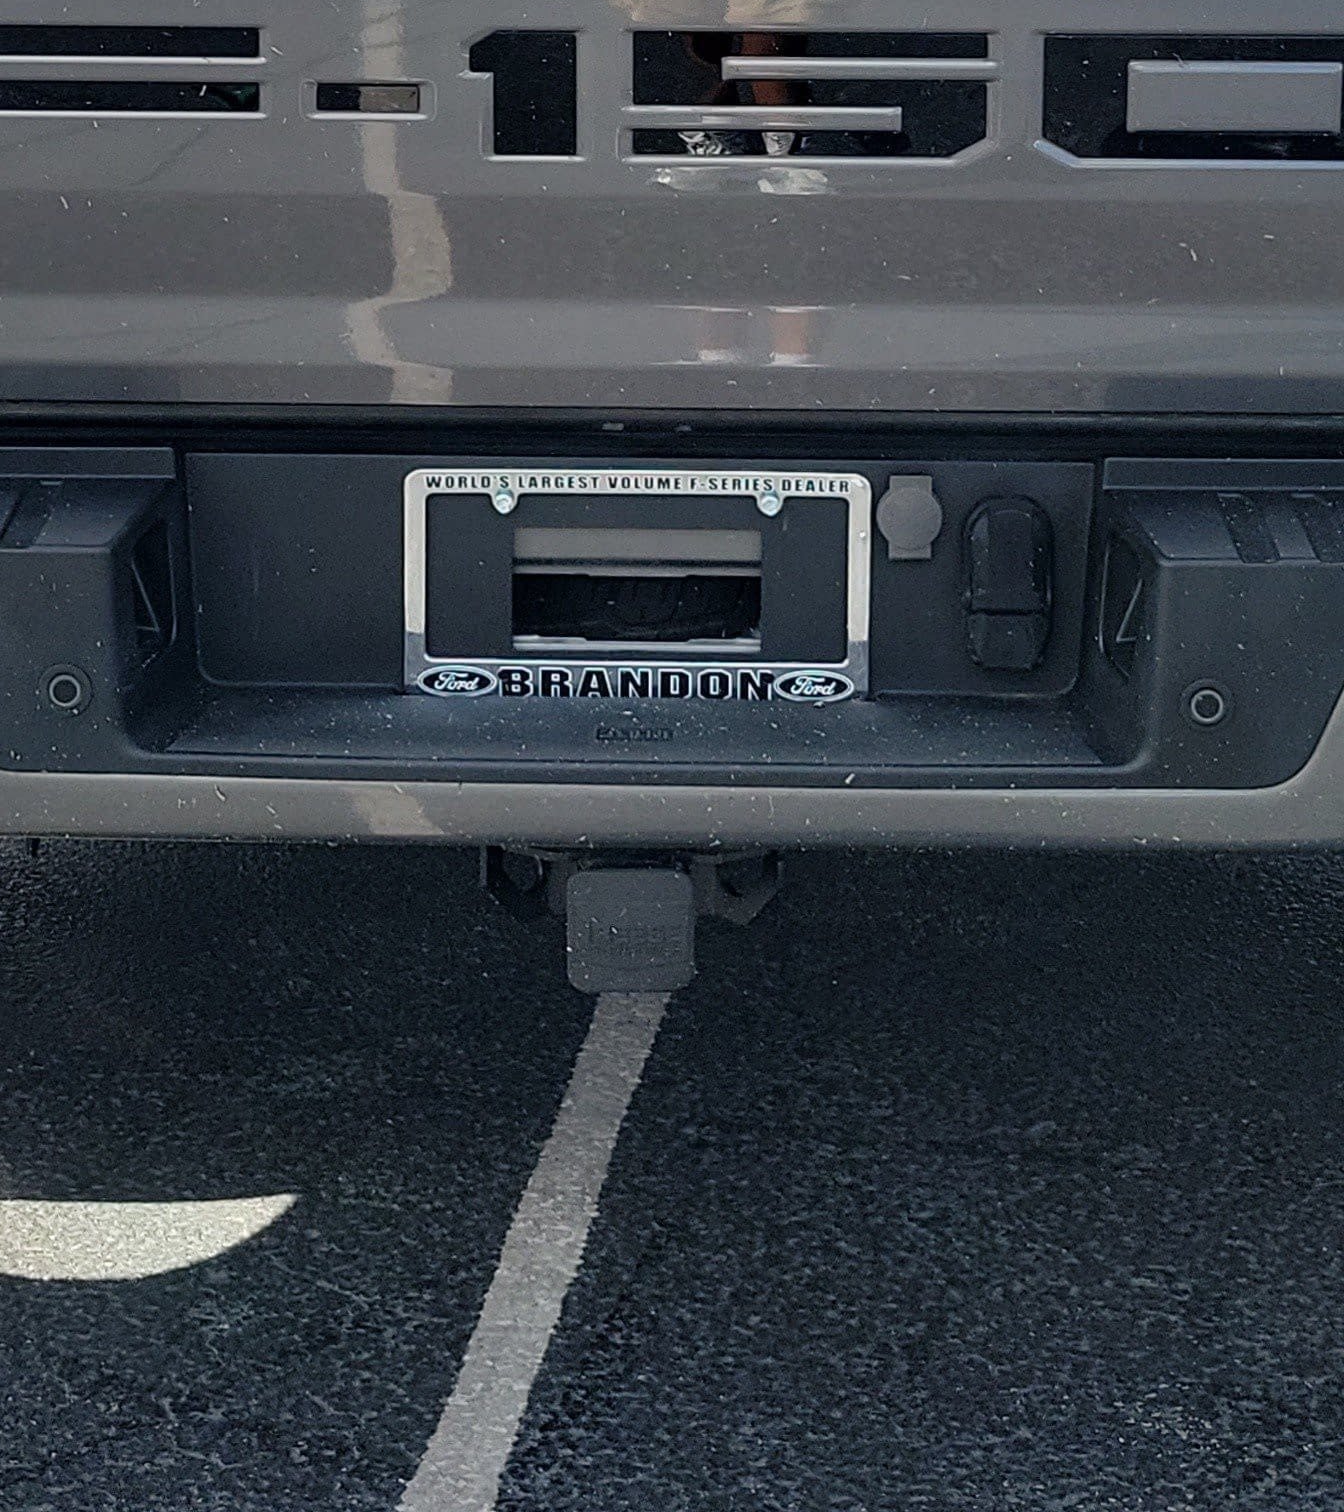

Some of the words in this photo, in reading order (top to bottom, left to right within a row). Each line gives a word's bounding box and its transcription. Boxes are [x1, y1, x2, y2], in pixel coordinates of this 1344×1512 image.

[425, 475, 510, 489] WORLD'S
[517, 475, 600, 489] LARGEST
[608, 476, 682, 490] VOLUME
[690, 477, 773, 492] F-SERIES
[781, 478, 850, 493] DEALER
[433, 672, 480, 692] Ford
[497, 667, 774, 701] BRANDON
[789, 675, 836, 696] Ford
